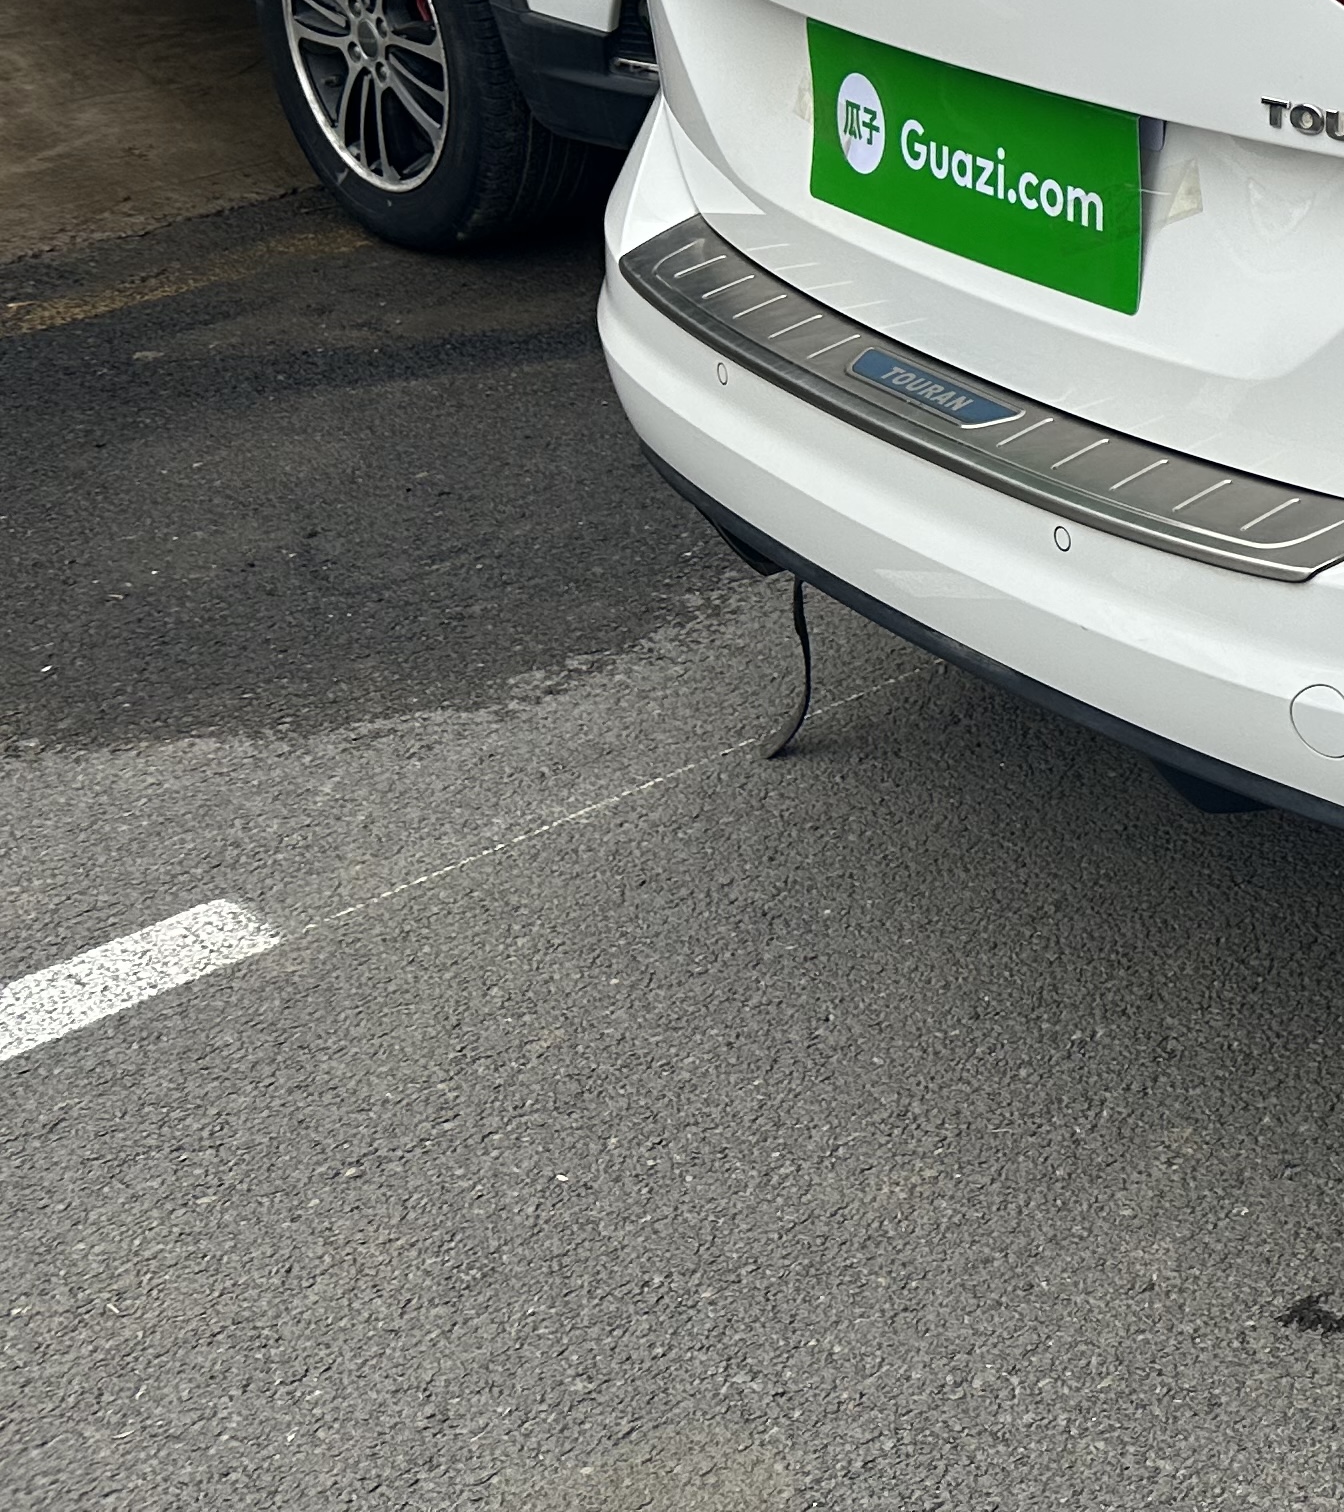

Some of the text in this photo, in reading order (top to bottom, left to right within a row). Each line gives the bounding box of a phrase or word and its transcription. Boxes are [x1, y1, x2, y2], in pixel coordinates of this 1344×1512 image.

[843, 99, 880, 145] 瓜子
[901, 119, 1104, 232] Guazi.com
[880, 366, 974, 411] TOURAN
